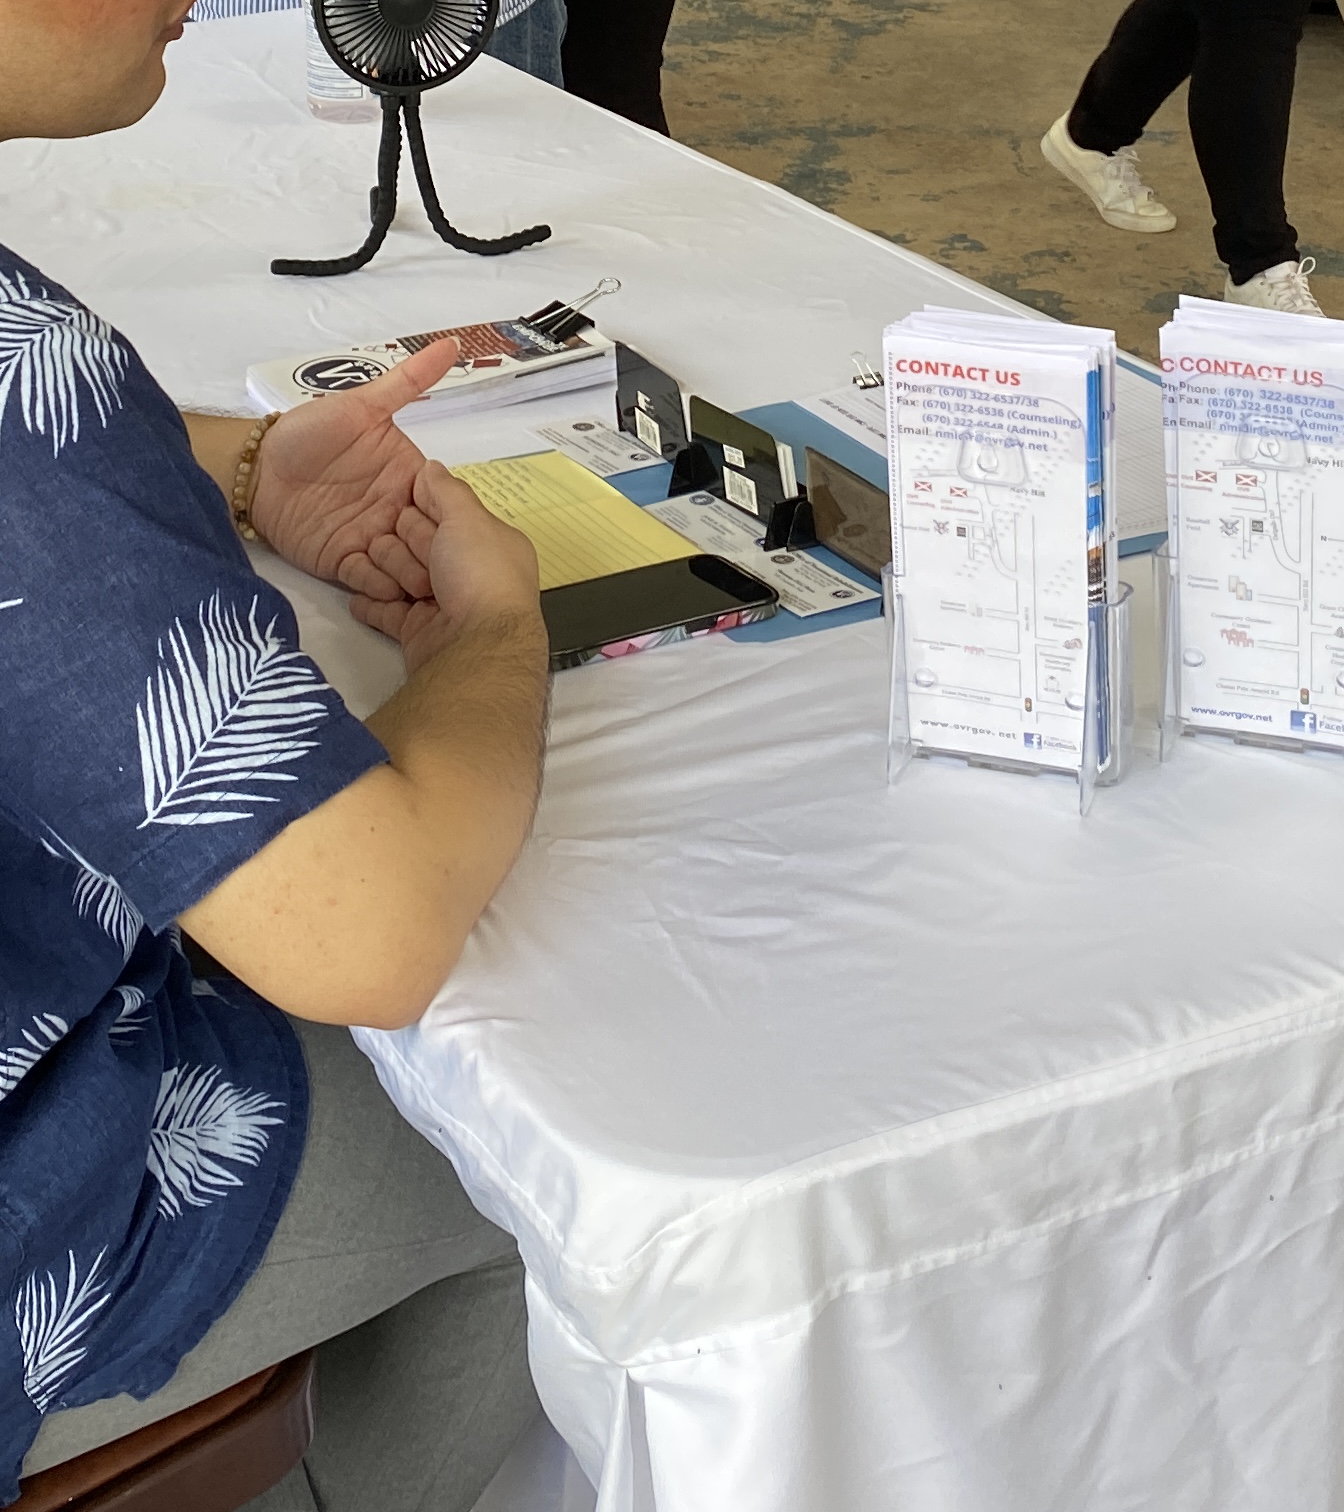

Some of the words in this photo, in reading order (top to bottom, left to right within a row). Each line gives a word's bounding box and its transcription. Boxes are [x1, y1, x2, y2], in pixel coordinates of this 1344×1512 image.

[896, 359, 989, 382] CONTACT
[994, 370, 1022, 386] US
[1180, 356, 1287, 383] CONTACT
[1293, 369, 1324, 388] US
[1191, 706, 1273, 722] www.ovrgov.net
